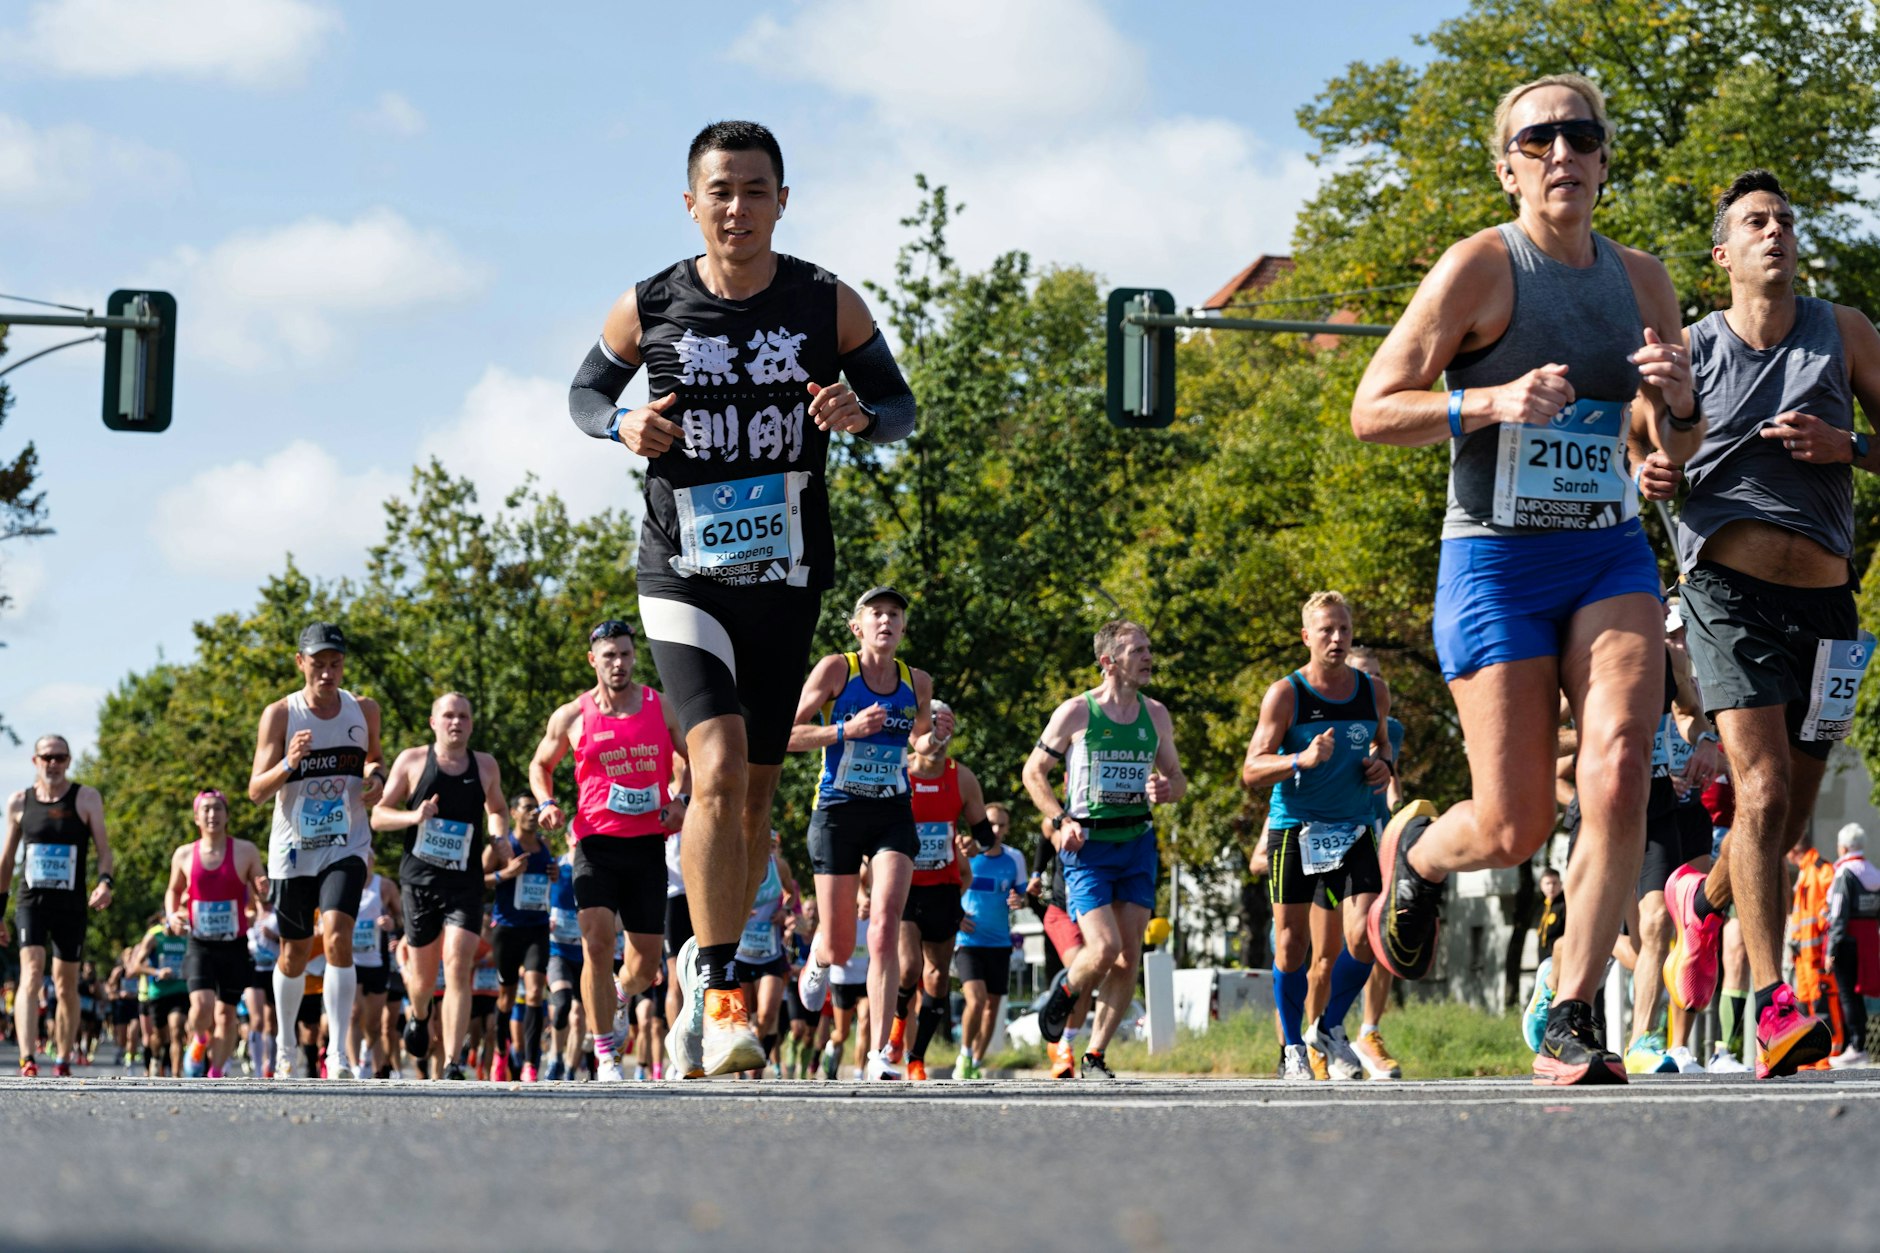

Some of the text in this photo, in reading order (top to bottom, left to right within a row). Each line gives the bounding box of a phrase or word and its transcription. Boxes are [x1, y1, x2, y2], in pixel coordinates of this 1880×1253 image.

[1553, 477, 1599, 494] Sarah
[791, 505, 798, 515] B
[1516, 499, 1592, 516] IMPOSSIBLE
[1516, 512, 1587, 529] IS NOTHING
[702, 512, 783, 547] 62056
[716, 546, 774, 561] xiaopeng
[701, 562, 760, 577] IMPOSSIBLE
[1828, 677, 1857, 700] 25
[599, 746, 628, 766] good
[1091, 750, 1134, 761] BILBOA
[300, 752, 360, 777] peixe pro
[605, 758, 657, 777] track club
[1102, 766, 1145, 780] 27896
[611, 787, 652, 805] 73032
[424, 832, 463, 850] 26980
